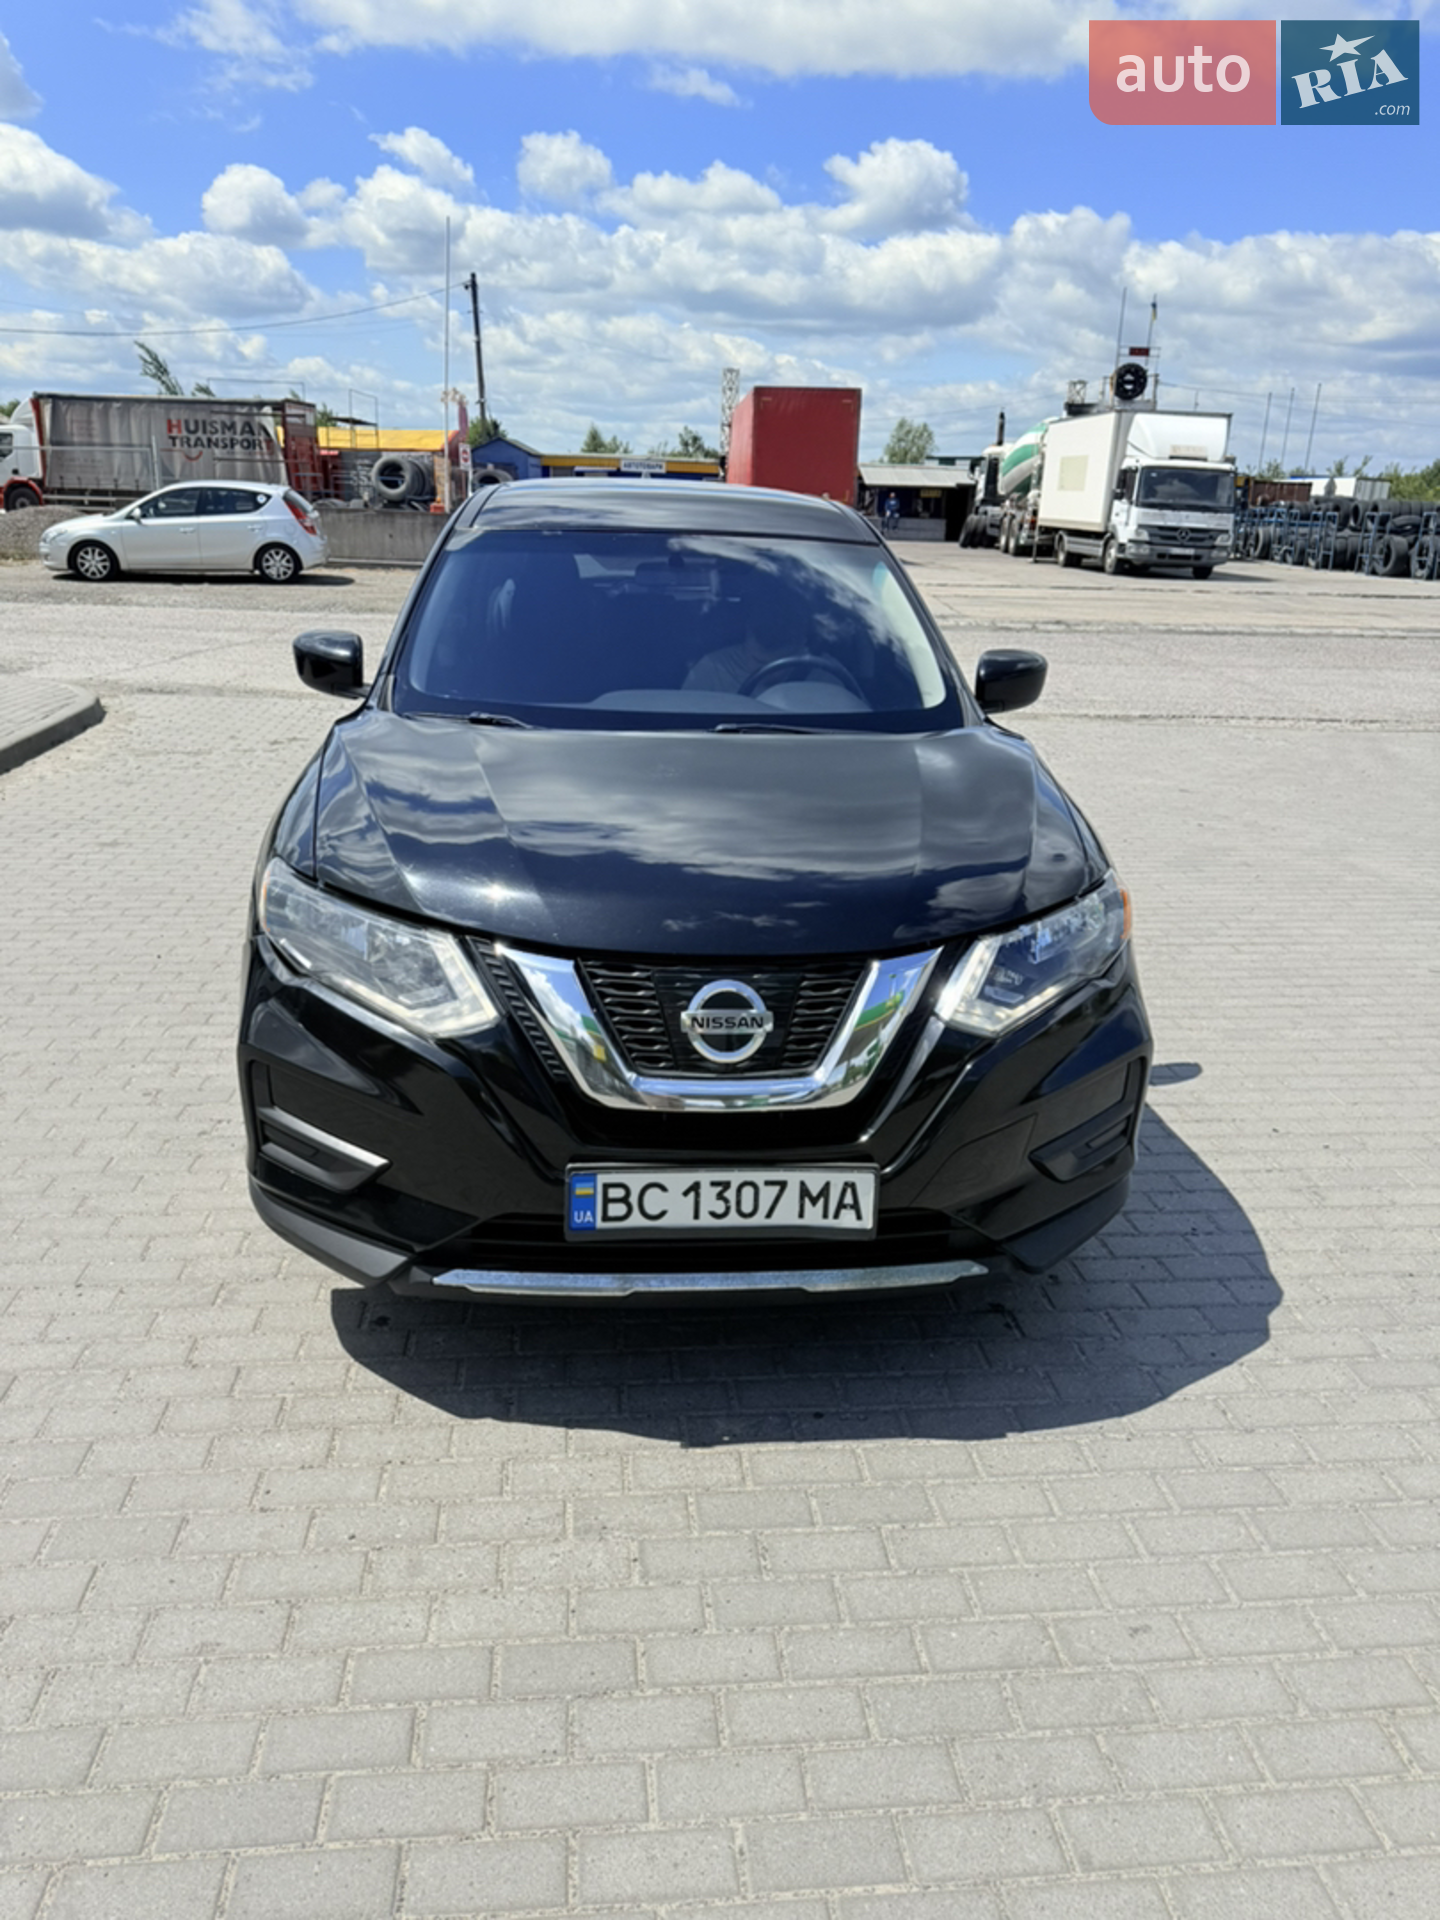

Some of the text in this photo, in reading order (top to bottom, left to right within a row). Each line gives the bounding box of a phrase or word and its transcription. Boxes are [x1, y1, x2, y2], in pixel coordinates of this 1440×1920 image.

[167, 419, 272, 438] HUISMAN
[168, 436, 274, 451] TRANSPORT
[691, 1016, 764, 1029] NISSAN
[601, 1180, 863, 1223] BC 1307 MA
[574, 1210, 594, 1224] UA
